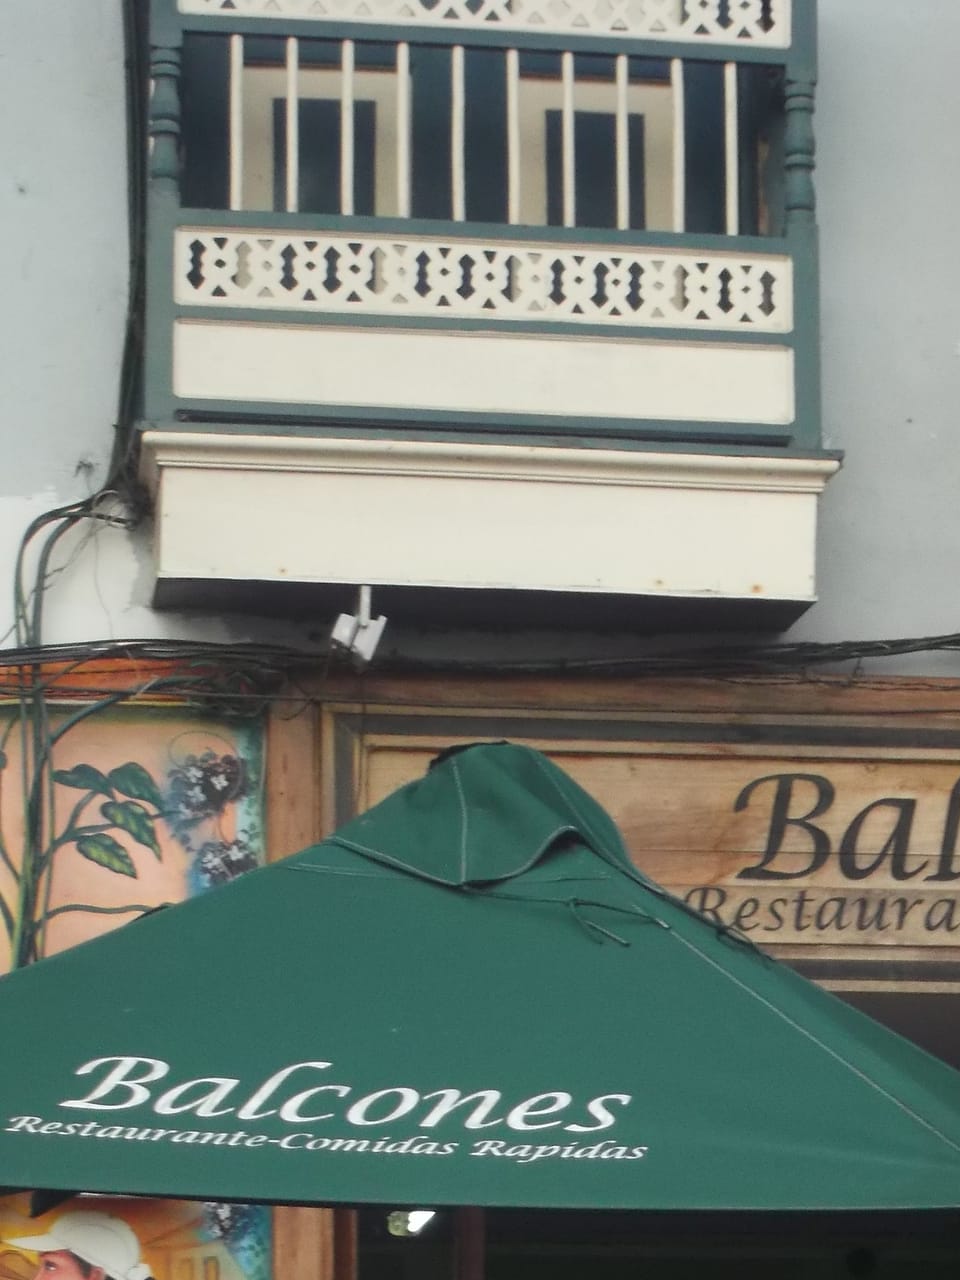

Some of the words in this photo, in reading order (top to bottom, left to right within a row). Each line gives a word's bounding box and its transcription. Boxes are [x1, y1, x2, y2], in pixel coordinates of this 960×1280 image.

[58, 1055, 632, 1133] Balcones
[5, 1115, 459, 1156] Restaurante-Comidas
[469, 1139, 649, 1163] Rapidas
